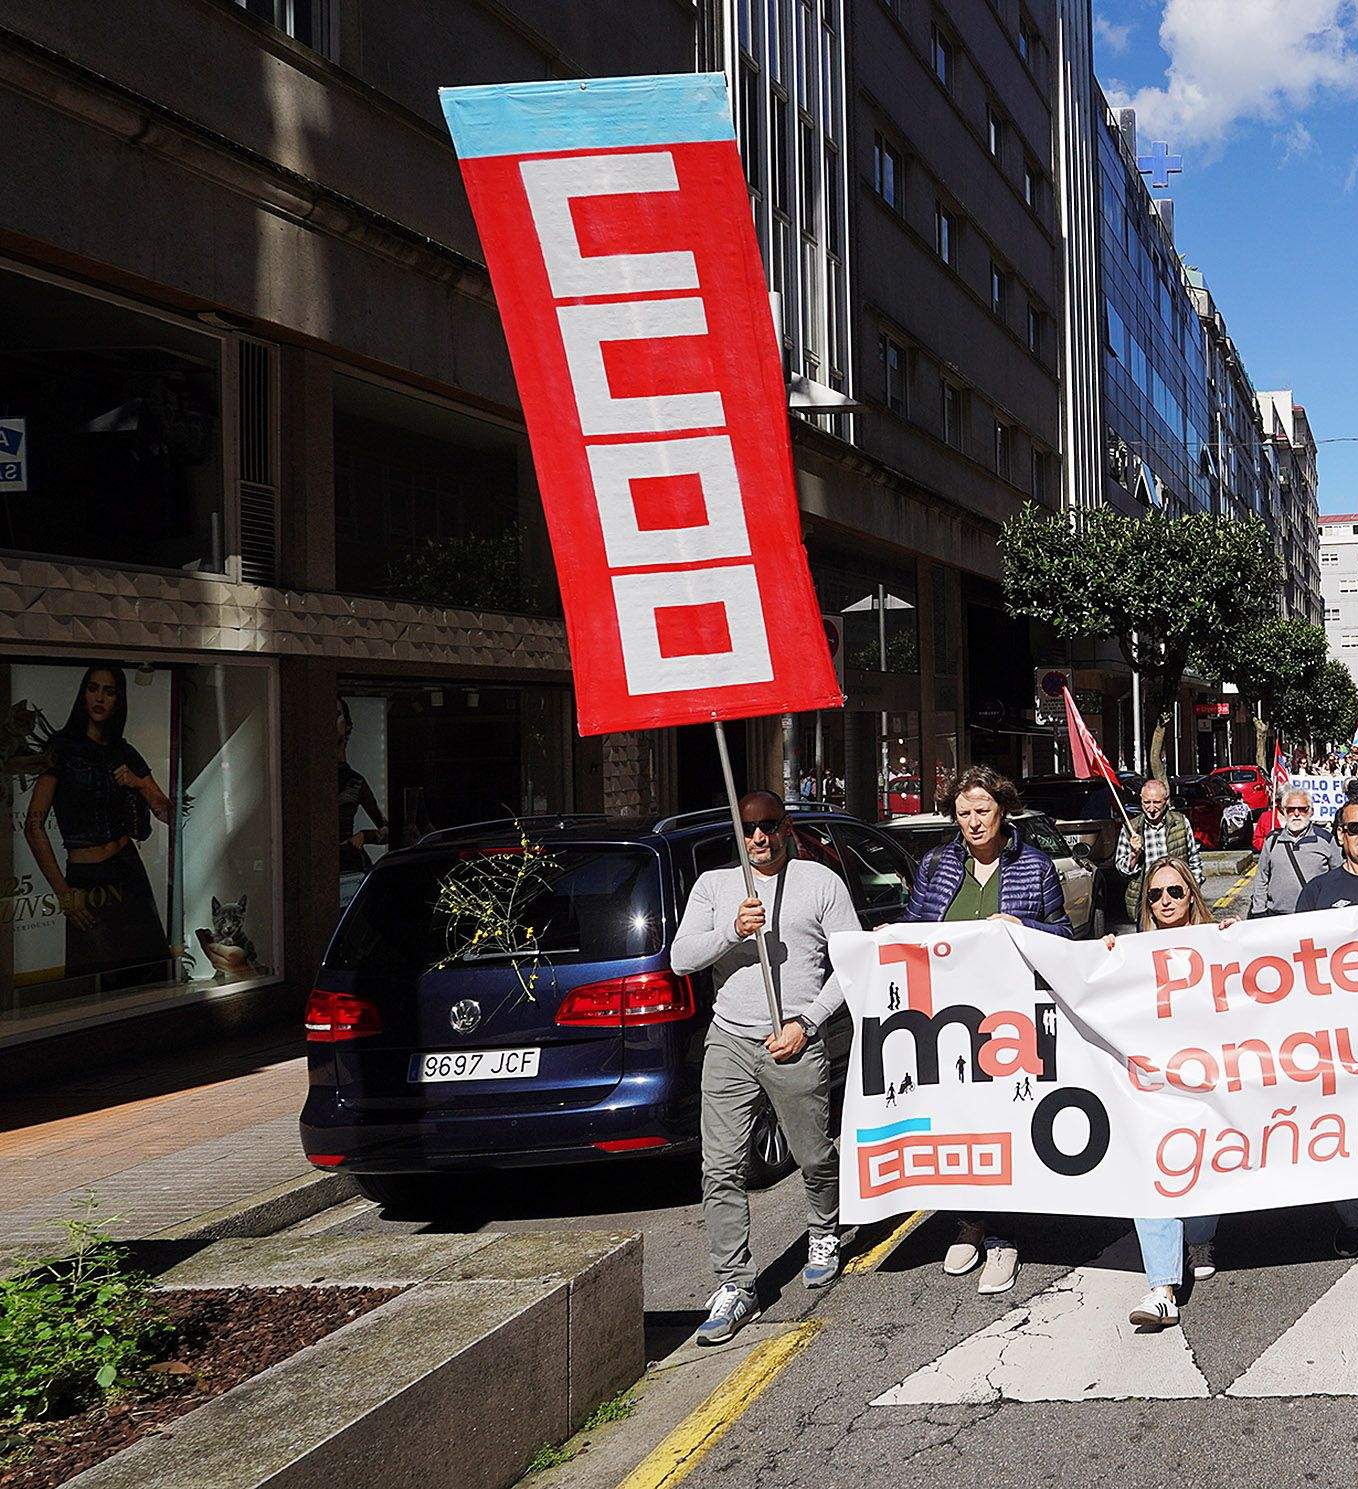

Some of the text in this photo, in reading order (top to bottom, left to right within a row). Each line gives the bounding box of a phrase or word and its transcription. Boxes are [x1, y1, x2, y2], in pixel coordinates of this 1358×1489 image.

[519, 152, 774, 697] CCOO
[424, 1051, 536, 1077] 9697 JCF
[868, 1143, 1002, 1188] CCOO
